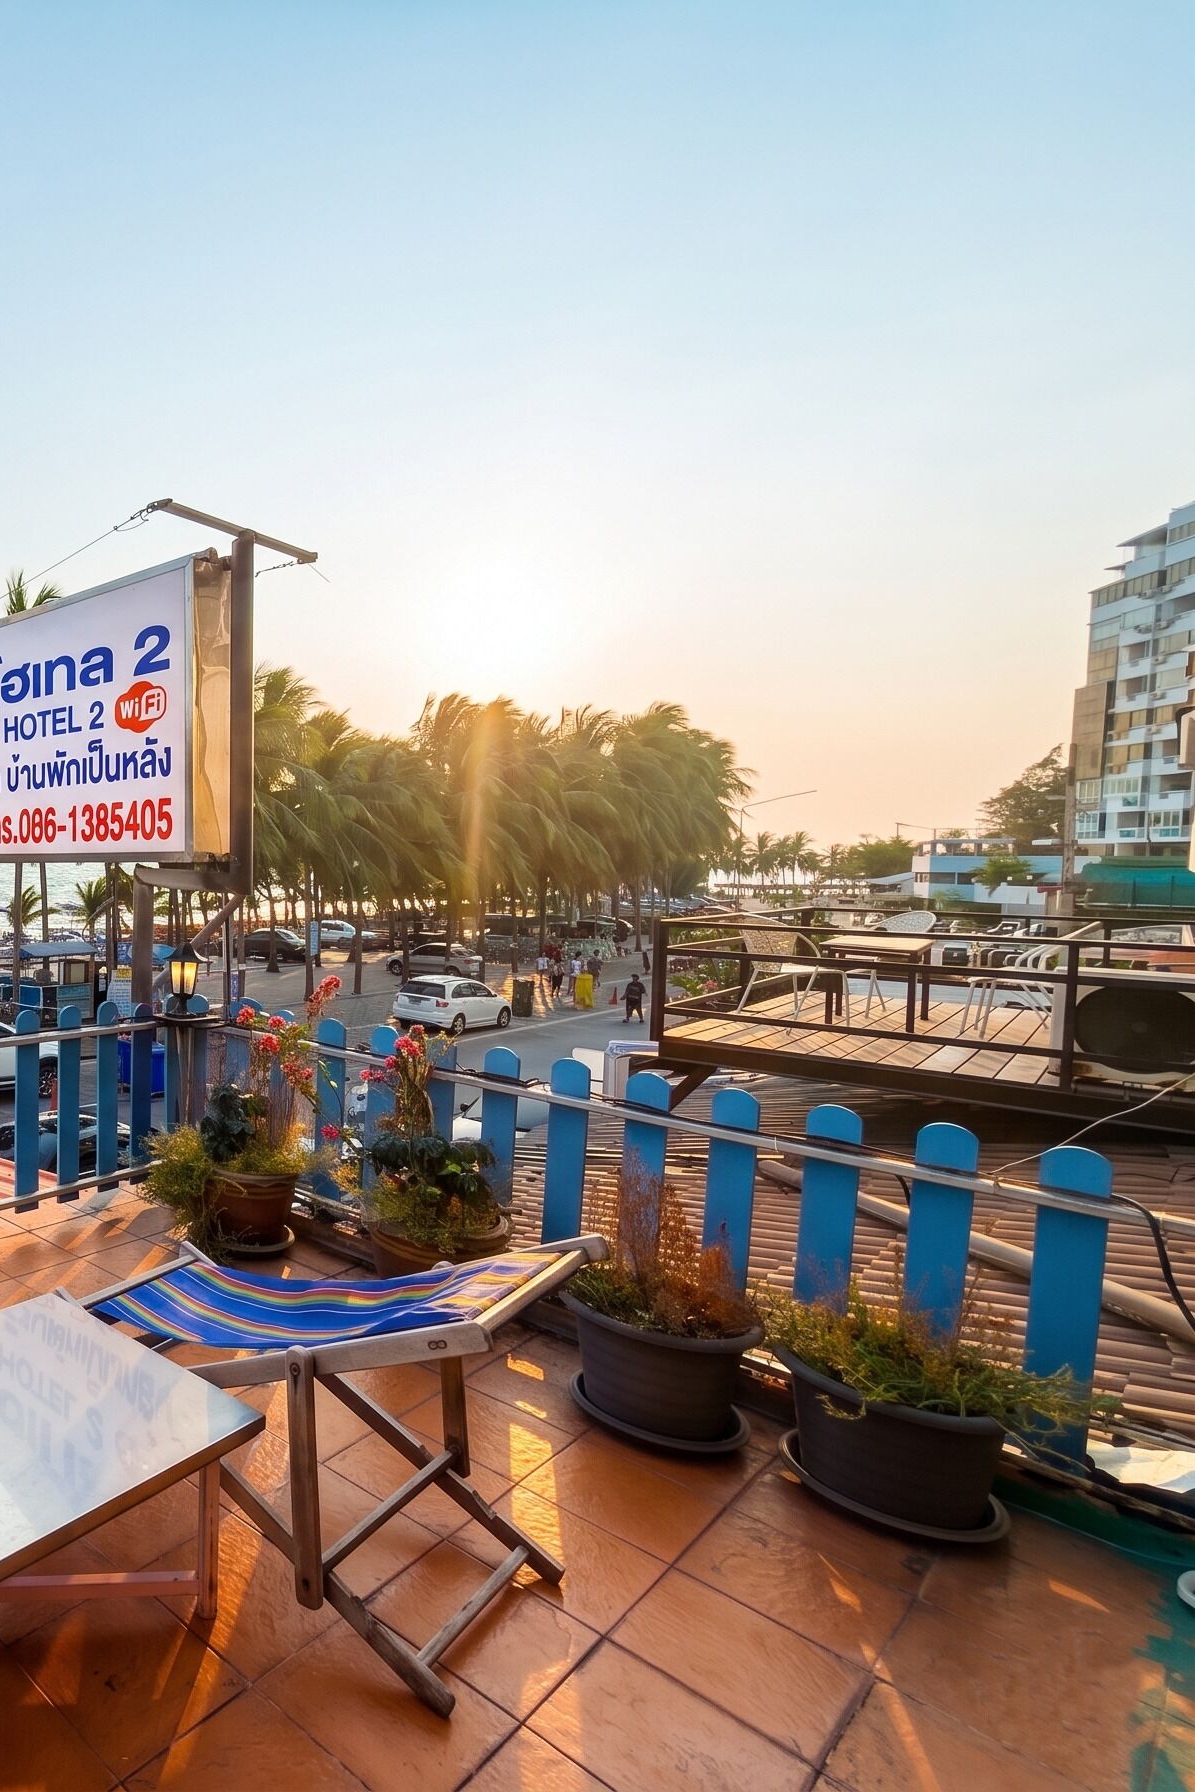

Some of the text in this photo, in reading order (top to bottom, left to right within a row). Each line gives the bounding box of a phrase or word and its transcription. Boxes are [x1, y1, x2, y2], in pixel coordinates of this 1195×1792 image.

[133, 624, 171, 677] 2
[4, 705, 82, 743] HOTEL
[89, 701, 104, 730] 2
